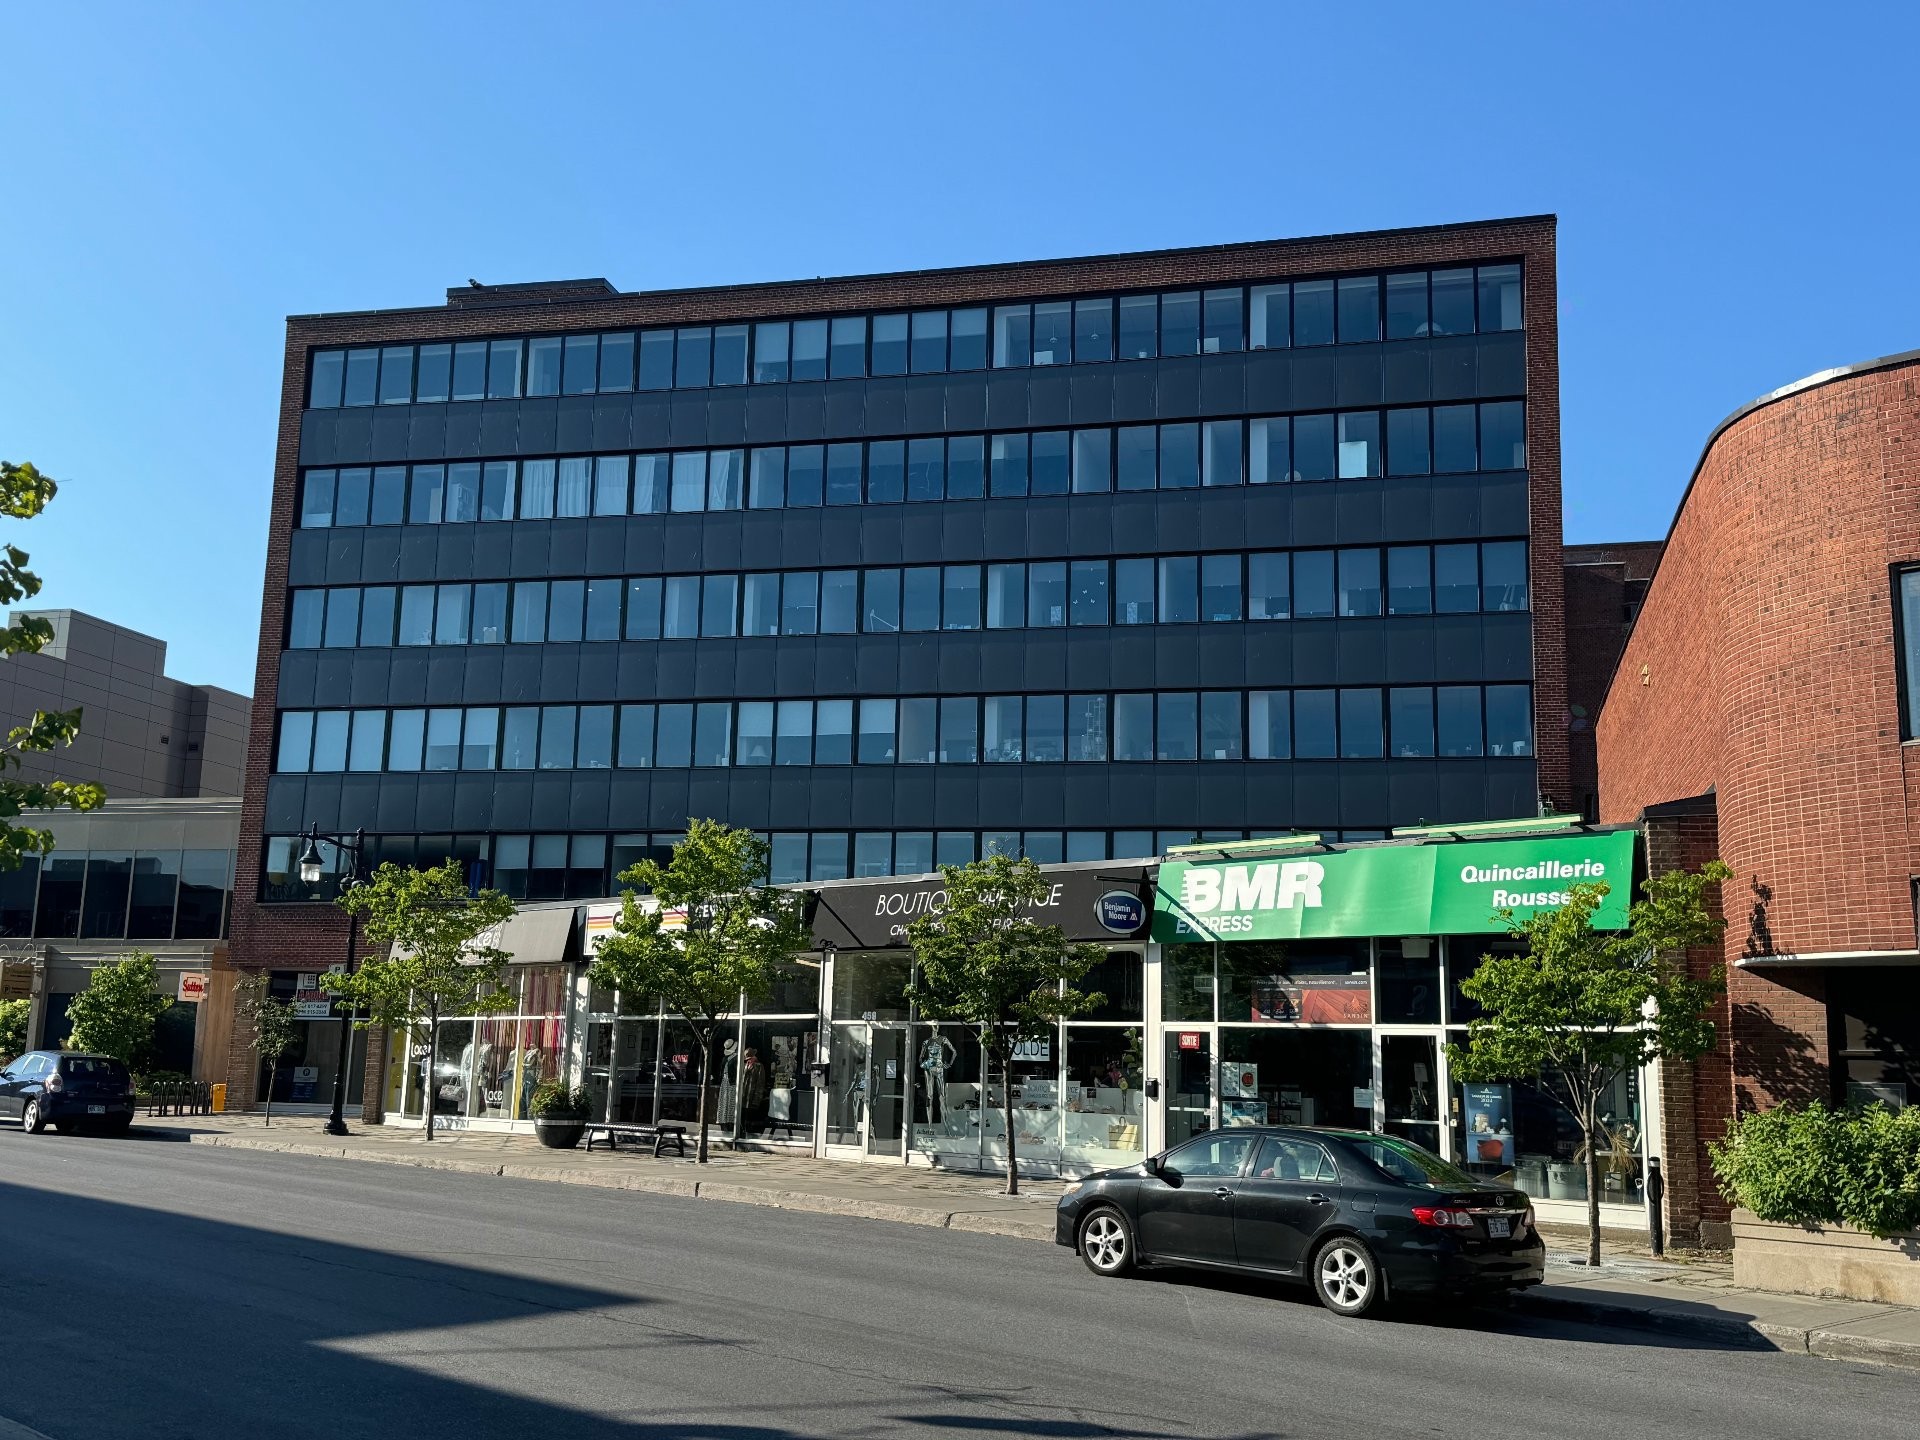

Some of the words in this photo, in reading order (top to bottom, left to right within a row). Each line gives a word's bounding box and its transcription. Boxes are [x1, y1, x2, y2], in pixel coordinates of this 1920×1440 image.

[1460, 859, 1605, 883] Quincaillerie
[1180, 861, 1325, 915] BMR
[875, 889, 973, 916] BOUTIQU
[1104, 902, 1130, 912] Benjamin
[1492, 890, 1603, 908] Rousse
[1108, 911, 1127, 921] Moore
[1175, 915, 1253, 934] EXPRESS
[1012, 1040, 1049, 1057] OLDE
